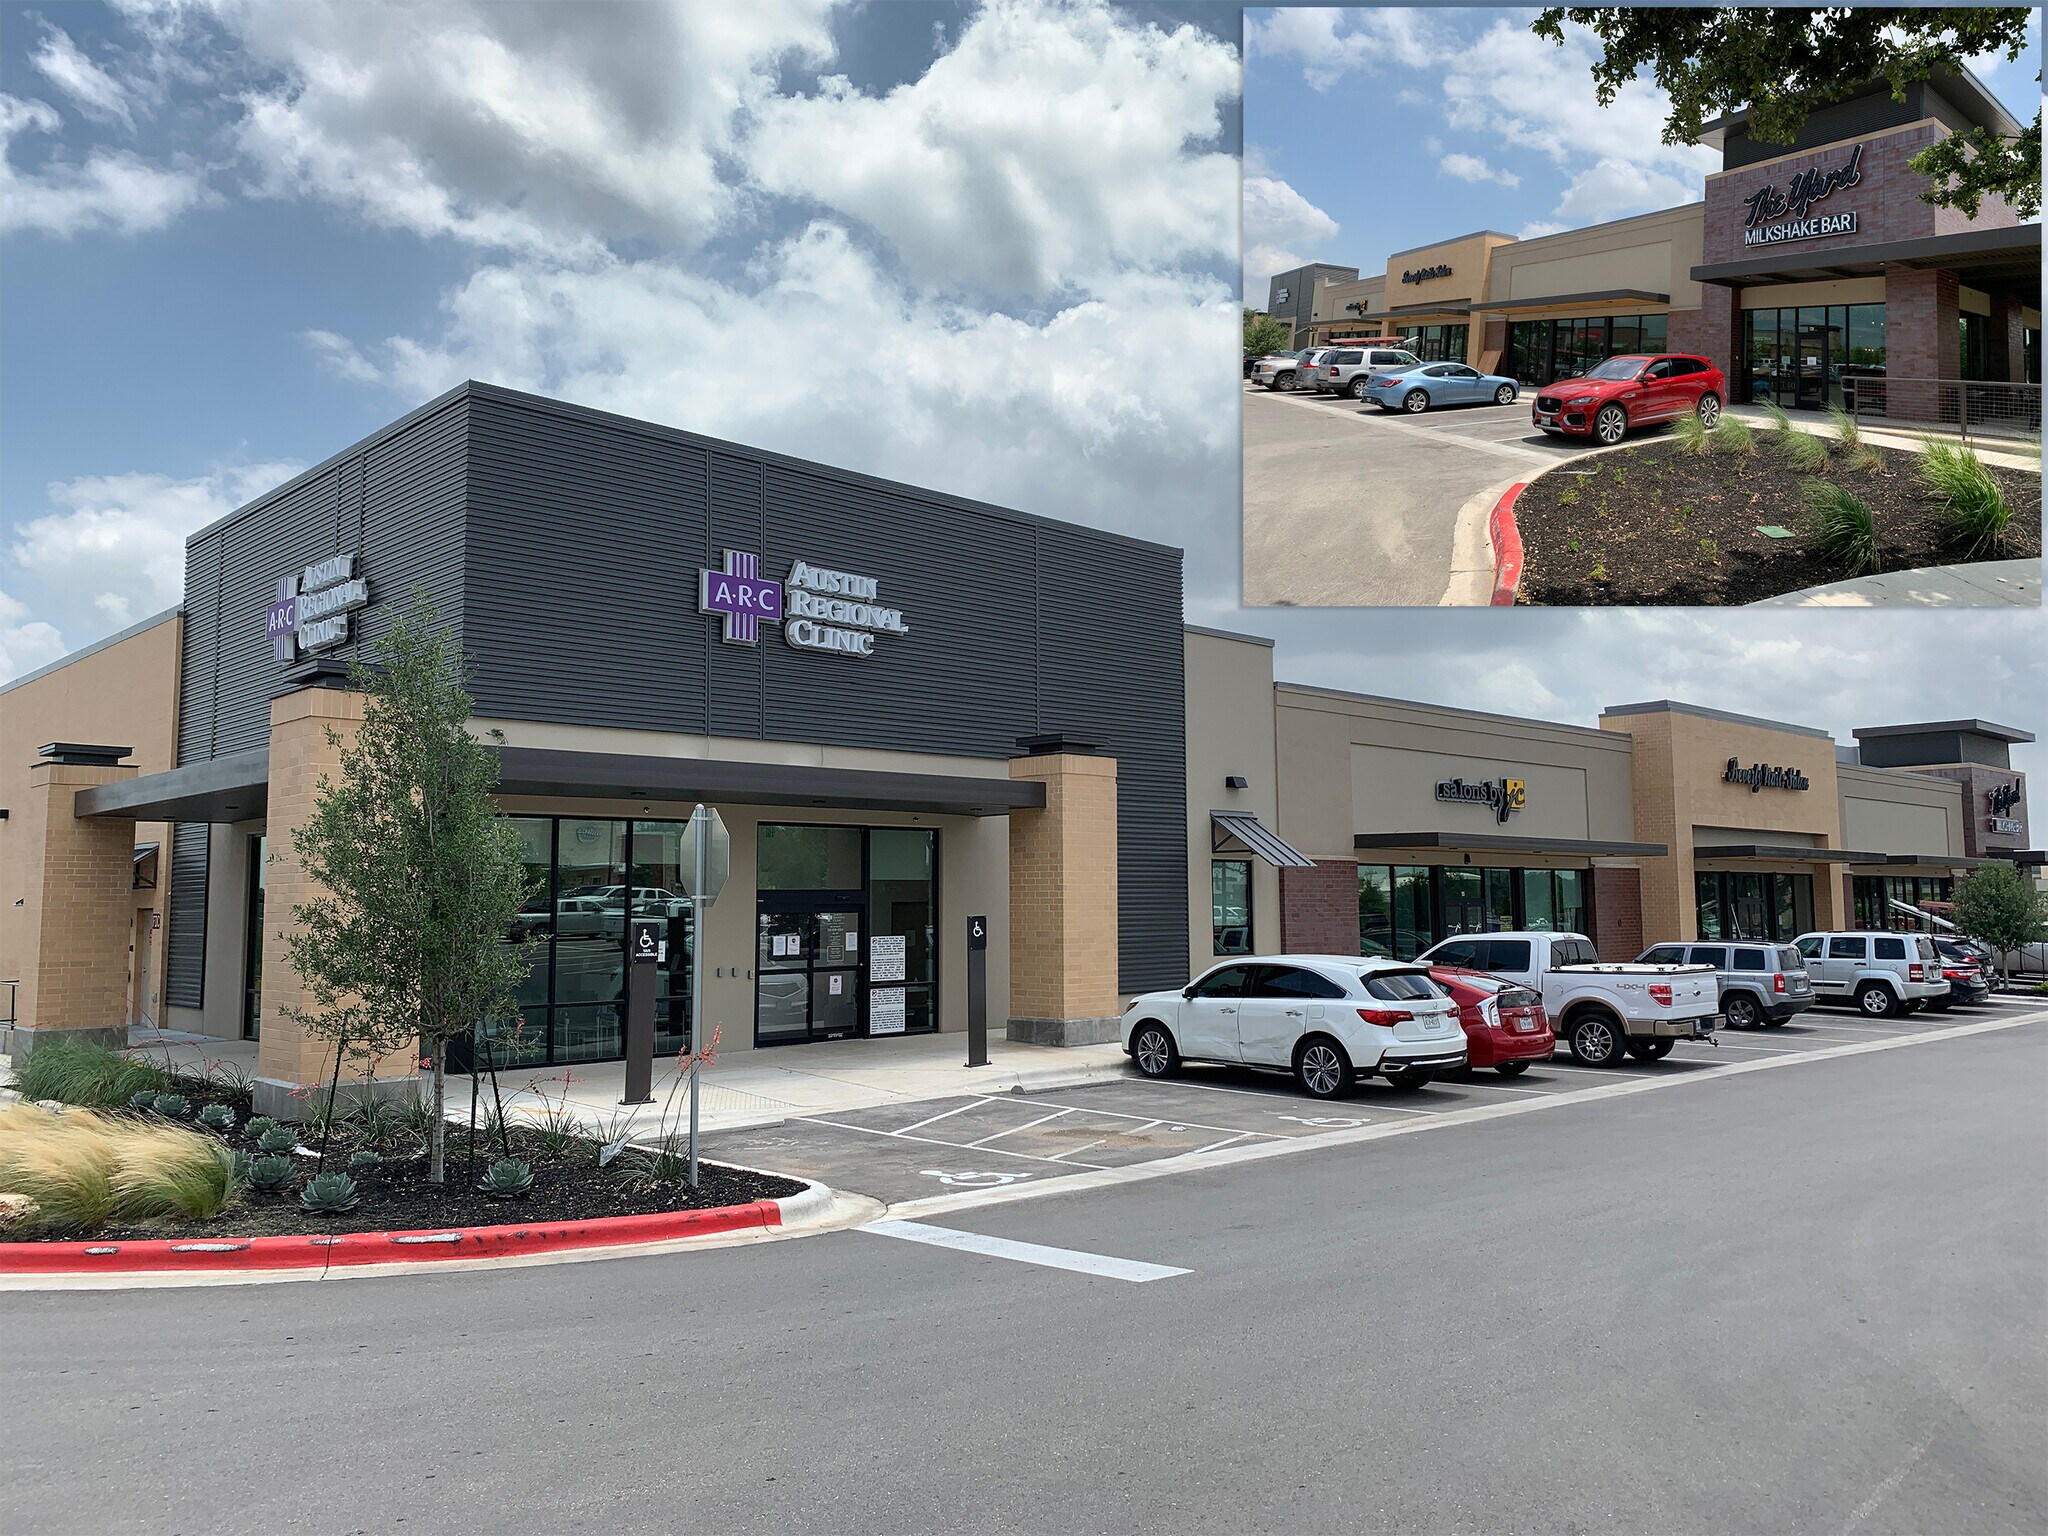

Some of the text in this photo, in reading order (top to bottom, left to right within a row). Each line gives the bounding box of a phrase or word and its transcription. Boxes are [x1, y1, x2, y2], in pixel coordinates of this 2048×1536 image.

[1744, 144, 1863, 228] The Yard
[1744, 214, 1851, 245] MILKSHAKE BAR
[788, 561, 879, 600] AUSTIN
[788, 590, 910, 632] REGIONAL
[788, 619, 875, 656] CLINIC
[1441, 779, 1488, 801] salons
[1489, 782, 1506, 807] by
